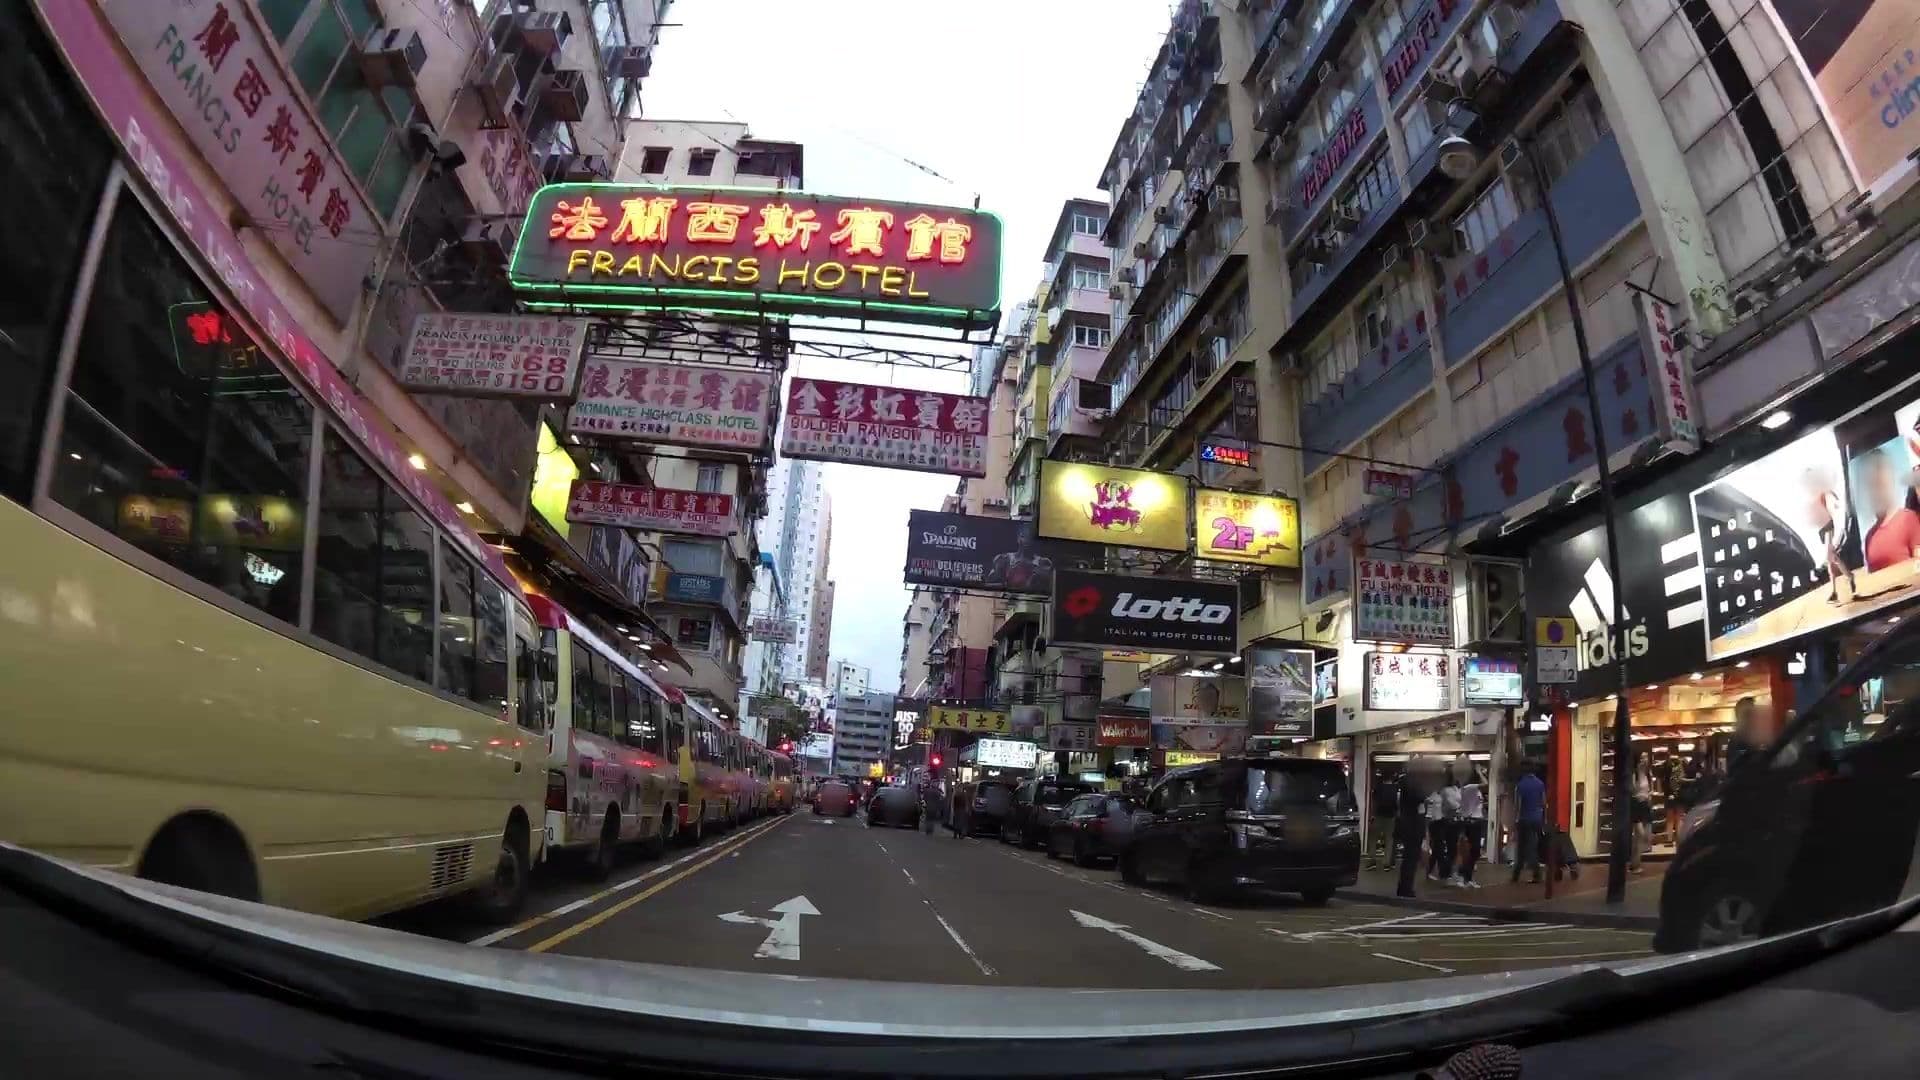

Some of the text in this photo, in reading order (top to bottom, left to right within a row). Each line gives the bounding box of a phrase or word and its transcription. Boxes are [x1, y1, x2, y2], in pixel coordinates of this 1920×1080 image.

[184, 0, 350, 238] 蘭西斯賓館
[156, 24, 313, 255] FRANCIS HOTEL
[549, 196, 972, 264] 法蘭西斯賓館
[567, 249, 930, 298] FRANCIS HOTEL
[575, 401, 636, 418] ROMANCE
[718, 415, 759, 431] HOTEL
[790, 417, 981, 449] GOLDEN RAINBOW HOTEL
[1211, 515, 1255, 551] 2F
[1711, 510, 1753, 538] NOT
[922, 532, 977, 549] SPALDING
[1714, 529, 1774, 563] MADE
[1416, 584, 1450, 599] HOTEL
[1720, 570, 1819, 613] NORMAL
[1111, 592, 1232, 624] lotto
[1104, 627, 1232, 642] ITALIAN SPORT DESIGN
[894, 711, 919, 722] JUST
[898, 722, 914, 733] DO
